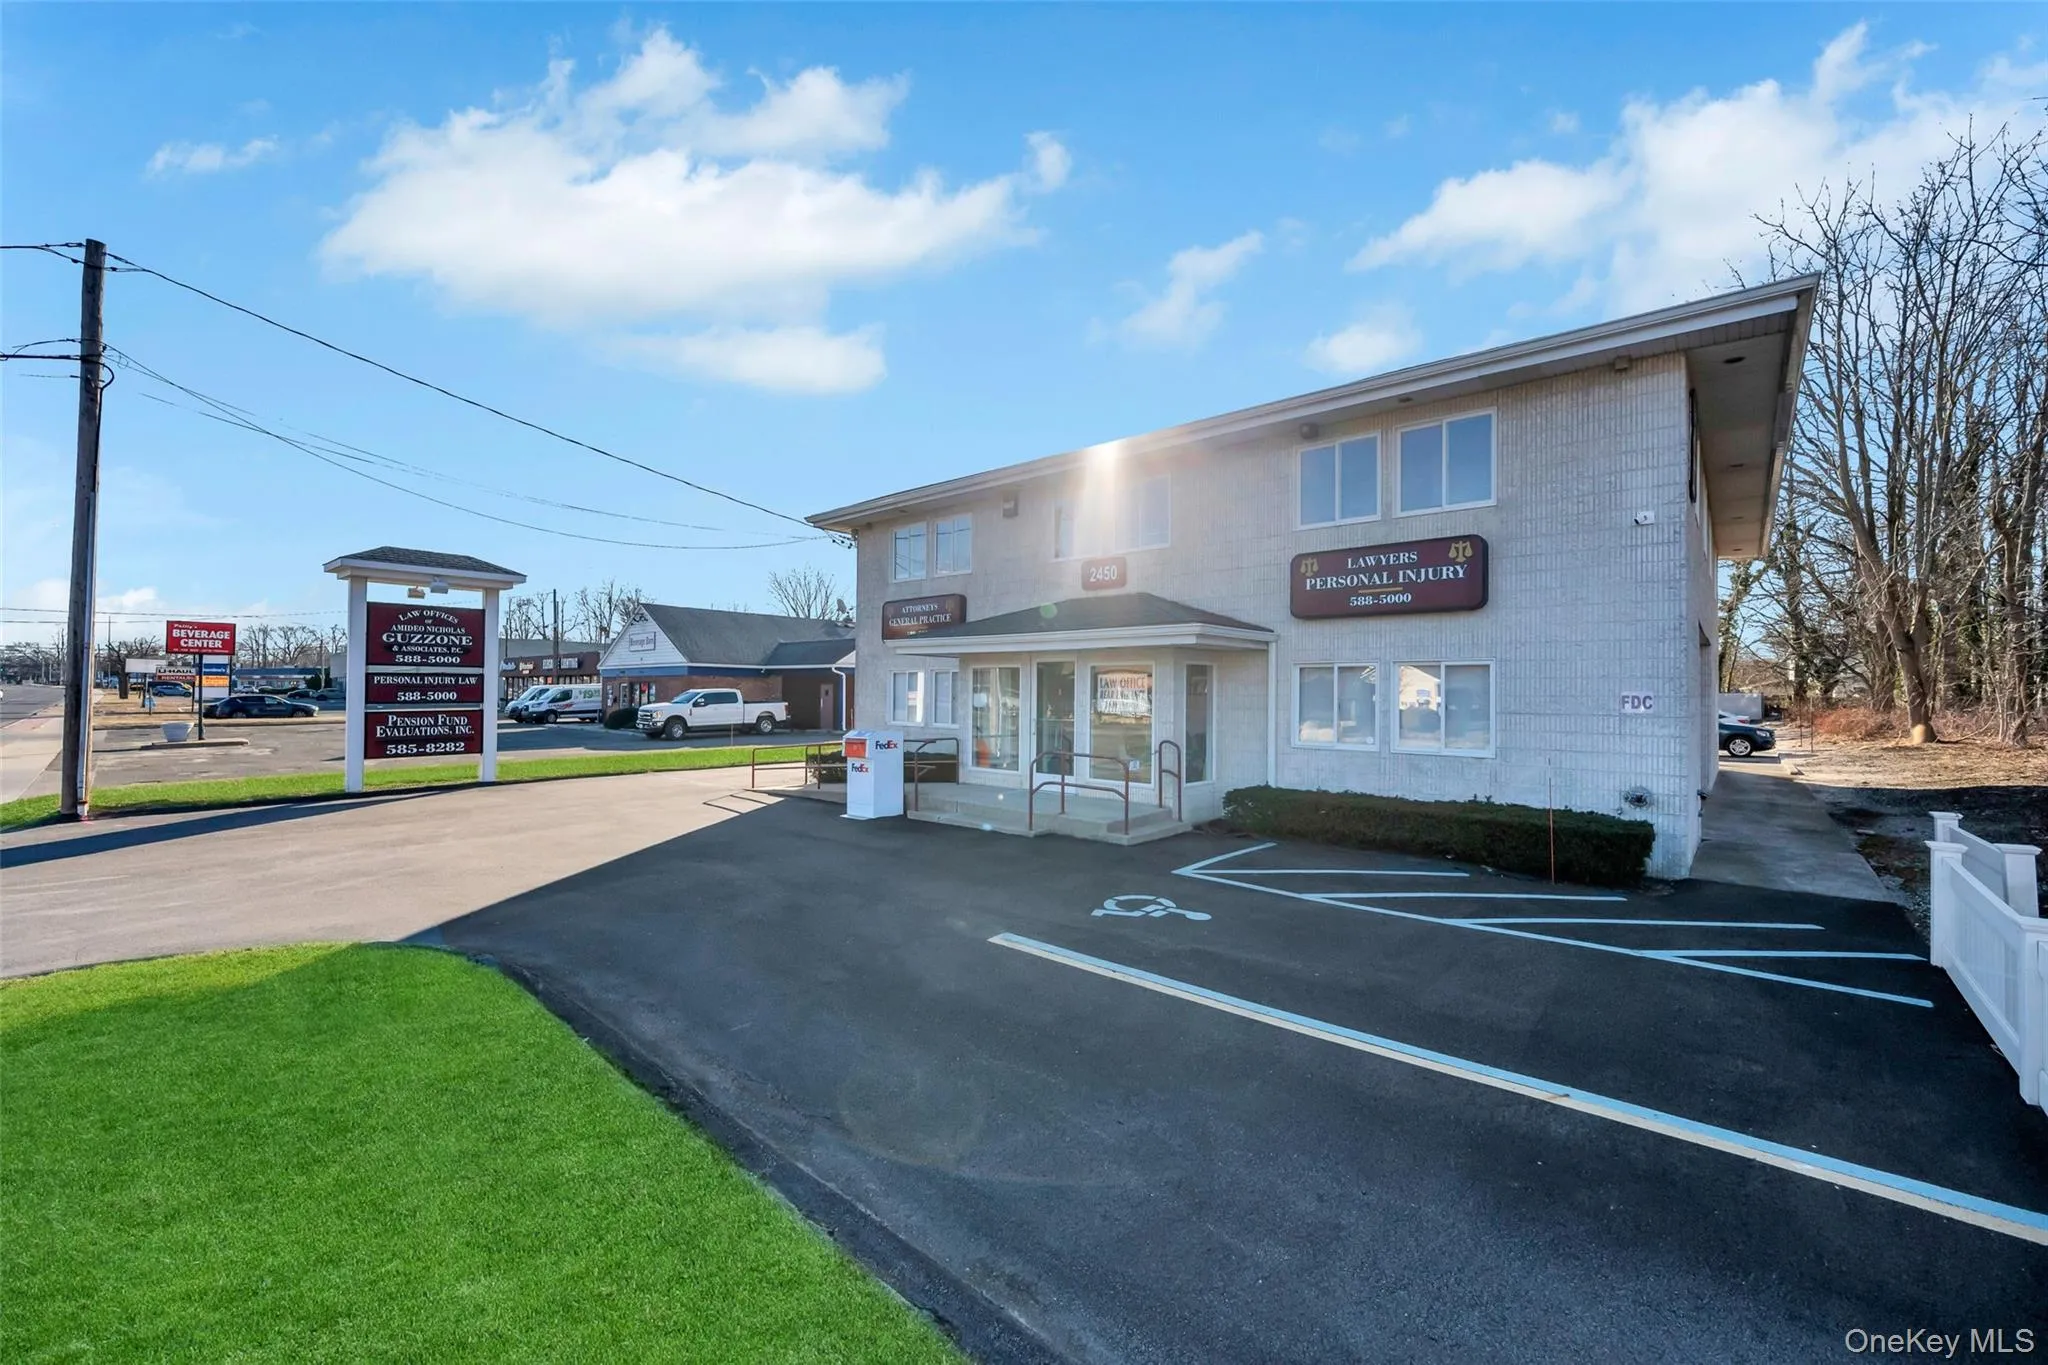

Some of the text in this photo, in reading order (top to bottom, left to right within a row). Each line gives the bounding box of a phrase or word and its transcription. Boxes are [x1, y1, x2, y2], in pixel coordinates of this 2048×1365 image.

[1347, 551, 1418, 569] LAWYERS
[1089, 565, 1118, 582] 2450
[1306, 564, 1468, 590] PERSONAL INJURY
[1349, 592, 1412, 607] 588-5000
[901, 604, 938, 613] ATTORNEYS
[398, 609, 459, 624] LAW OFFICES
[888, 613, 952, 627] GENERAL PRACTICE
[172, 629, 230, 639] BEVERAGE
[390, 624, 466, 634] AMIDEO NICHOLAS
[180, 639, 222, 648] CENTER
[382, 632, 473, 646] GUZZONE
[395, 655, 460, 664] 588-5000
[374, 675, 478, 686] PERSONAL INJURY LAW
[397, 691, 457, 701] 588-5000
[1621, 695, 1653, 710] FDC
[388, 714, 468, 727] PENSION FUND
[376, 726, 475, 738] EVALUATIONS, INC.
[386, 742, 465, 755] 585-8282
[875, 740, 898, 750] FedEx
[851, 763, 869, 773] FedEx
